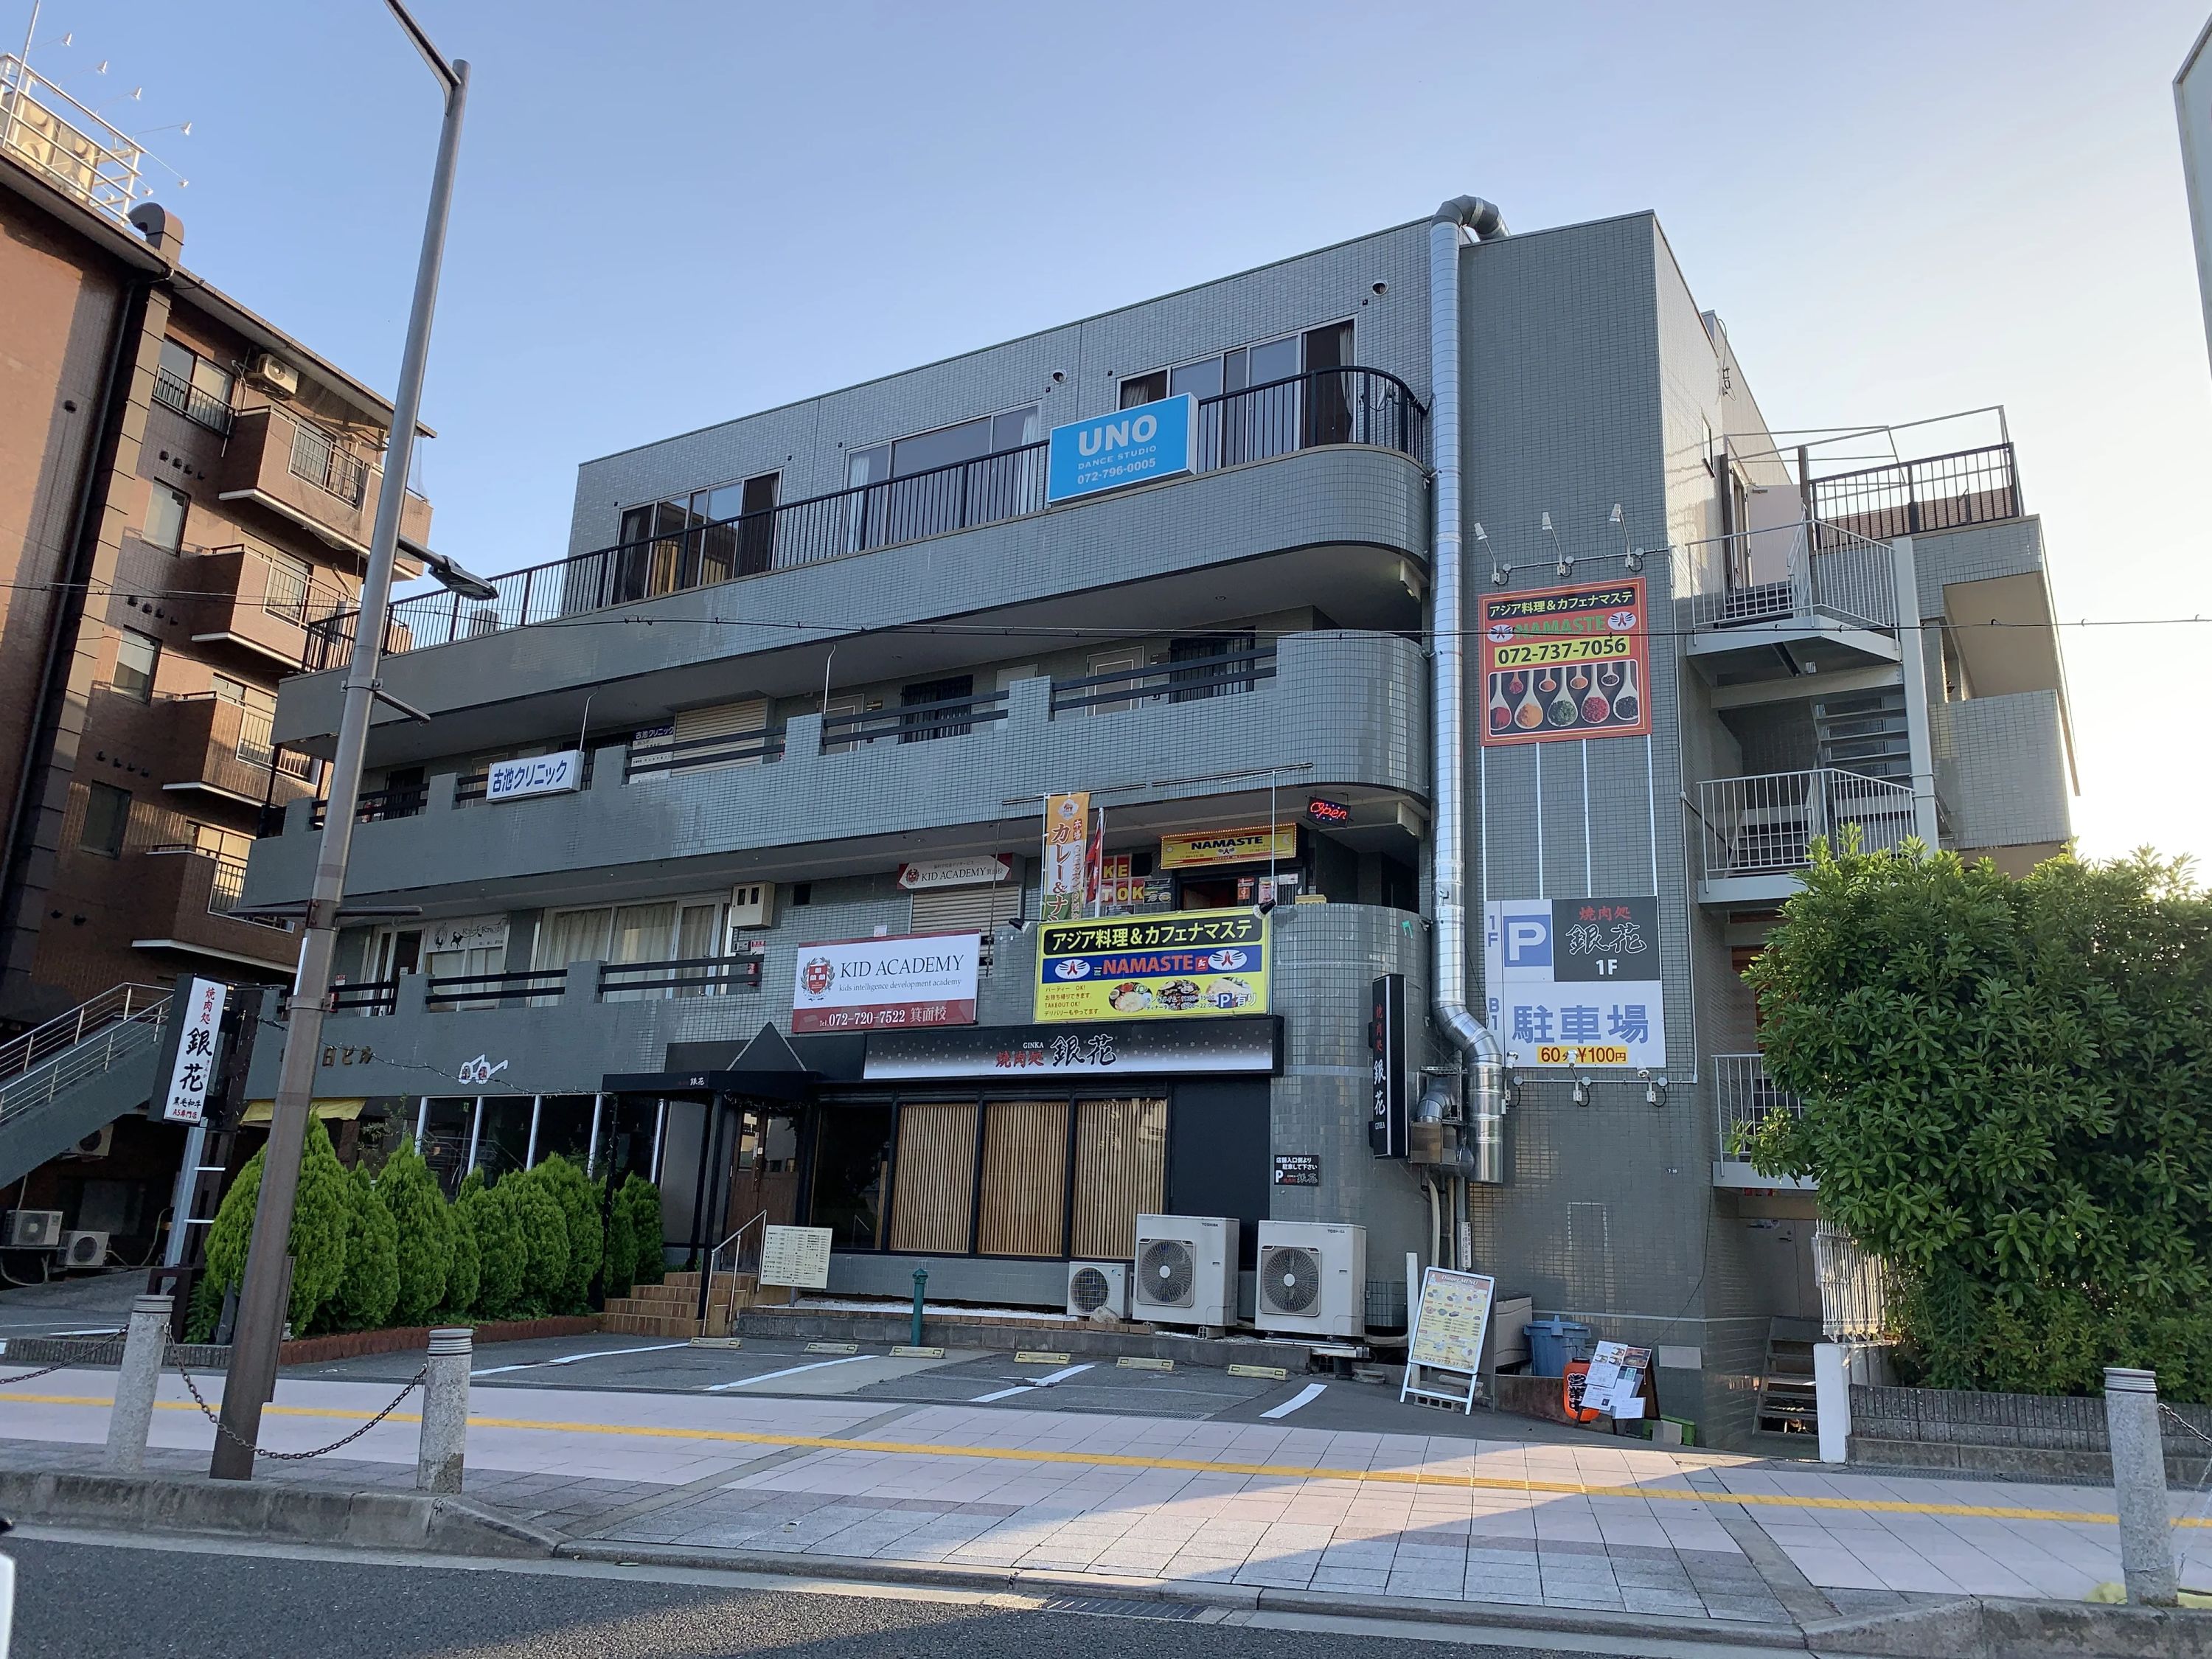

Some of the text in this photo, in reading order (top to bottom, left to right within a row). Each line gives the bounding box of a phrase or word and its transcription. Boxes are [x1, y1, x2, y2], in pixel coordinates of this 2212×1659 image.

[1078, 414, 1158, 456] UNO
[1077, 445, 1157, 470] DANCE STUDIO
[1077, 457, 1156, 485] 072-796-0005
[1514, 615, 1607, 640] NAMASTE
[1498, 638, 1627, 664] 072-737-7056
[636, 726, 674, 740] 古池クリニック
[492, 759, 568, 793] 古池クリニック
[1191, 836, 1263, 850] NAMASTE
[922, 872, 938, 882] KID
[939, 867, 987, 880] ACADEMY
[1508, 922, 1547, 961] P
[1565, 922, 1647, 956] 銀花
[840, 954, 964, 978] KID ACADEMY
[1103, 954, 1194, 975] NAMASTE
[1596, 959, 1618, 975] 1F
[853, 981, 888, 992] intelligence
[890, 980, 931, 990] development
[933, 978, 962, 987] academy
[1220, 994, 1231, 1008] P
[1235, 992, 1257, 1007] 有り
[1512, 1004, 1649, 1044] 駐車場
[179, 1027, 213, 1092] 銀花
[1050, 1034, 1117, 1067] 銀花
[1373, 1059, 1386, 1116] 銀花
[173, 1096, 202, 1108] 黒毛和牛
[1275, 1169, 1284, 1183] P
